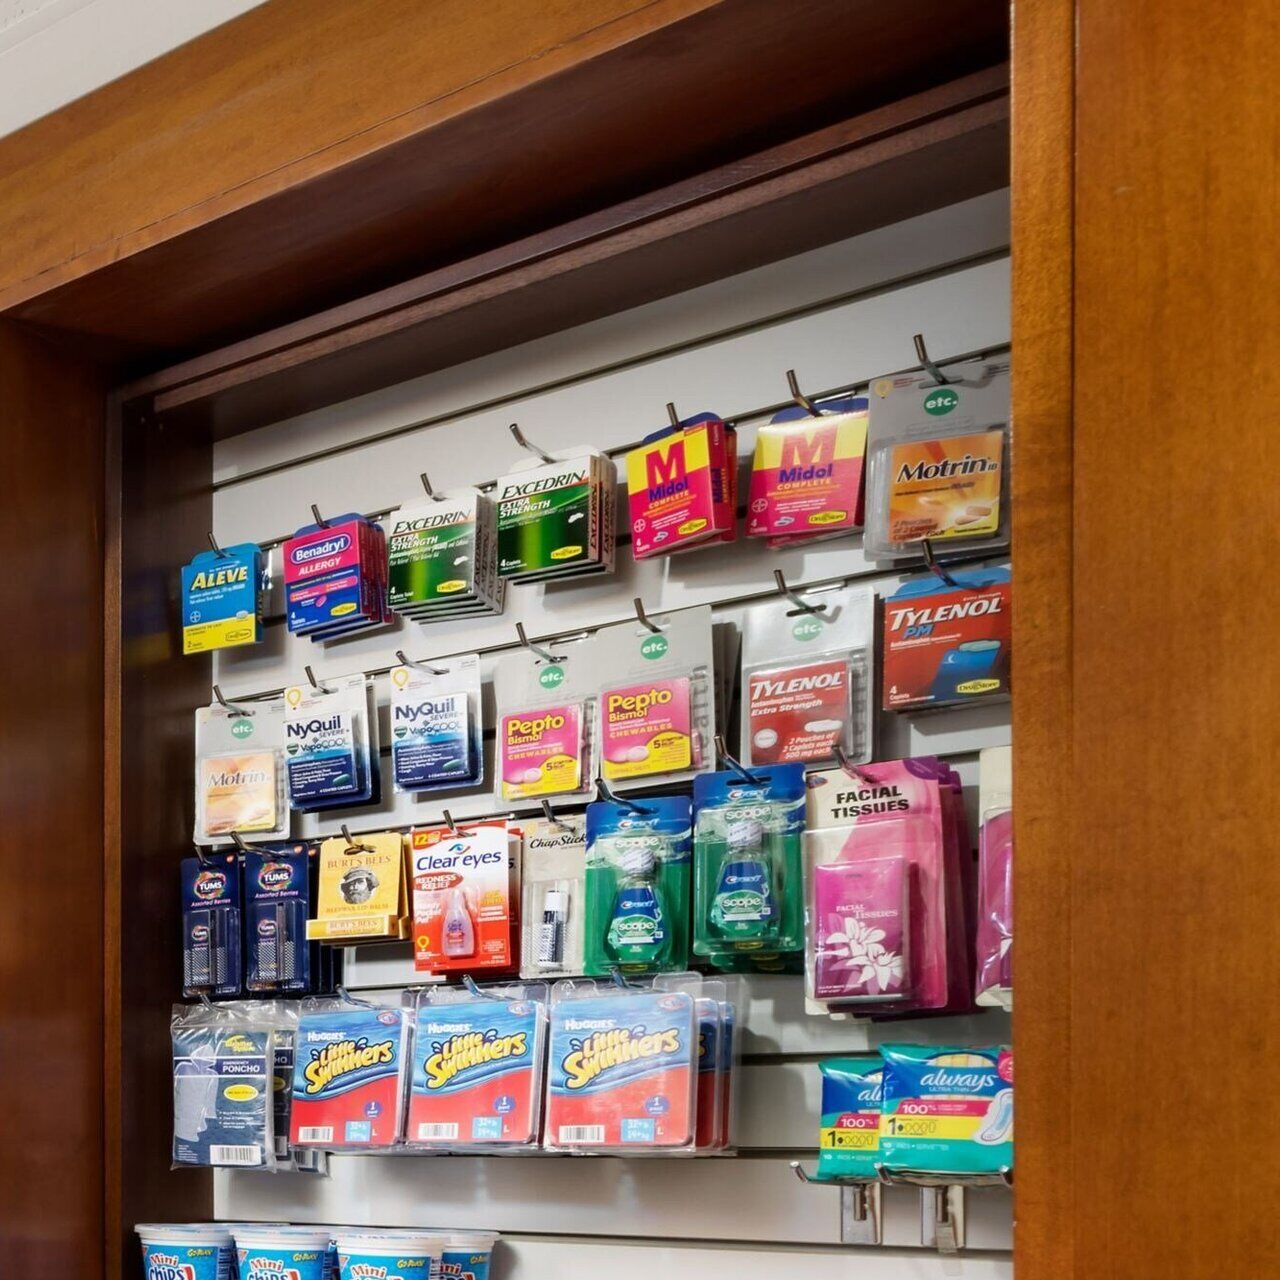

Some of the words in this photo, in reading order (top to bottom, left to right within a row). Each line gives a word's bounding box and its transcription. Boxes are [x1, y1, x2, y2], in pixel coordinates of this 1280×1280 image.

[925, 397, 957, 410] etc.
[645, 442, 686, 483] M
[897, 456, 988, 483] Motrin
[778, 465, 833, 482] Midol
[648, 477, 688, 502] Midol
[648, 491, 690, 509] COMPLETE
[393, 509, 472, 534] EXCEDRIN
[391, 534, 419, 546] EXTRA
[391, 536, 439, 551] STRENGTH
[295, 538, 346, 562] Benadryl
[298, 557, 341, 576] ALLERGY
[191, 566, 248, 591] ALEVE
[889, 598, 1002, 631] TYLENOL
[903, 625, 932, 639] PM
[750, 671, 844, 699] TYLENOL
[890, 686, 897, 695] 4
[608, 688, 672, 712] Pepto
[889, 692, 910, 700] Caplets
[395, 698, 455, 722] NyQuil
[609, 708, 647, 722] Bismol
[751, 705, 787, 717] Extra
[789, 699, 823, 712] Strength
[287, 716, 341, 741] NyQuil
[319, 728, 345, 738] SEVERE
[609, 722, 672, 739] CHEWABLES
[836, 785, 902, 804] FACIAL
[831, 798, 910, 819] TISSUES
[530, 834, 587, 849] ChapStick
[327, 856, 356, 869] BURT'S
[362, 854, 392, 866] BEES
[417, 855, 460, 871] Clear
[462, 852, 501, 871] eyes
[264, 871, 290, 882] TUMS
[415, 875, 457, 884] REDNESS
[198, 882, 223, 892] TUMS
[421, 881, 449, 889] RELIEF
[279, 889, 299, 897] Berries
[853, 908, 898, 919] Tissues
[618, 921, 655, 934] scope
[308, 1032, 346, 1041] HUGGIES
[222, 1065, 260, 1073] PONCHO
[920, 1069, 999, 1092] always
[150, 1254, 178, 1267] Mini
[250, 1258, 283, 1272] Mini
